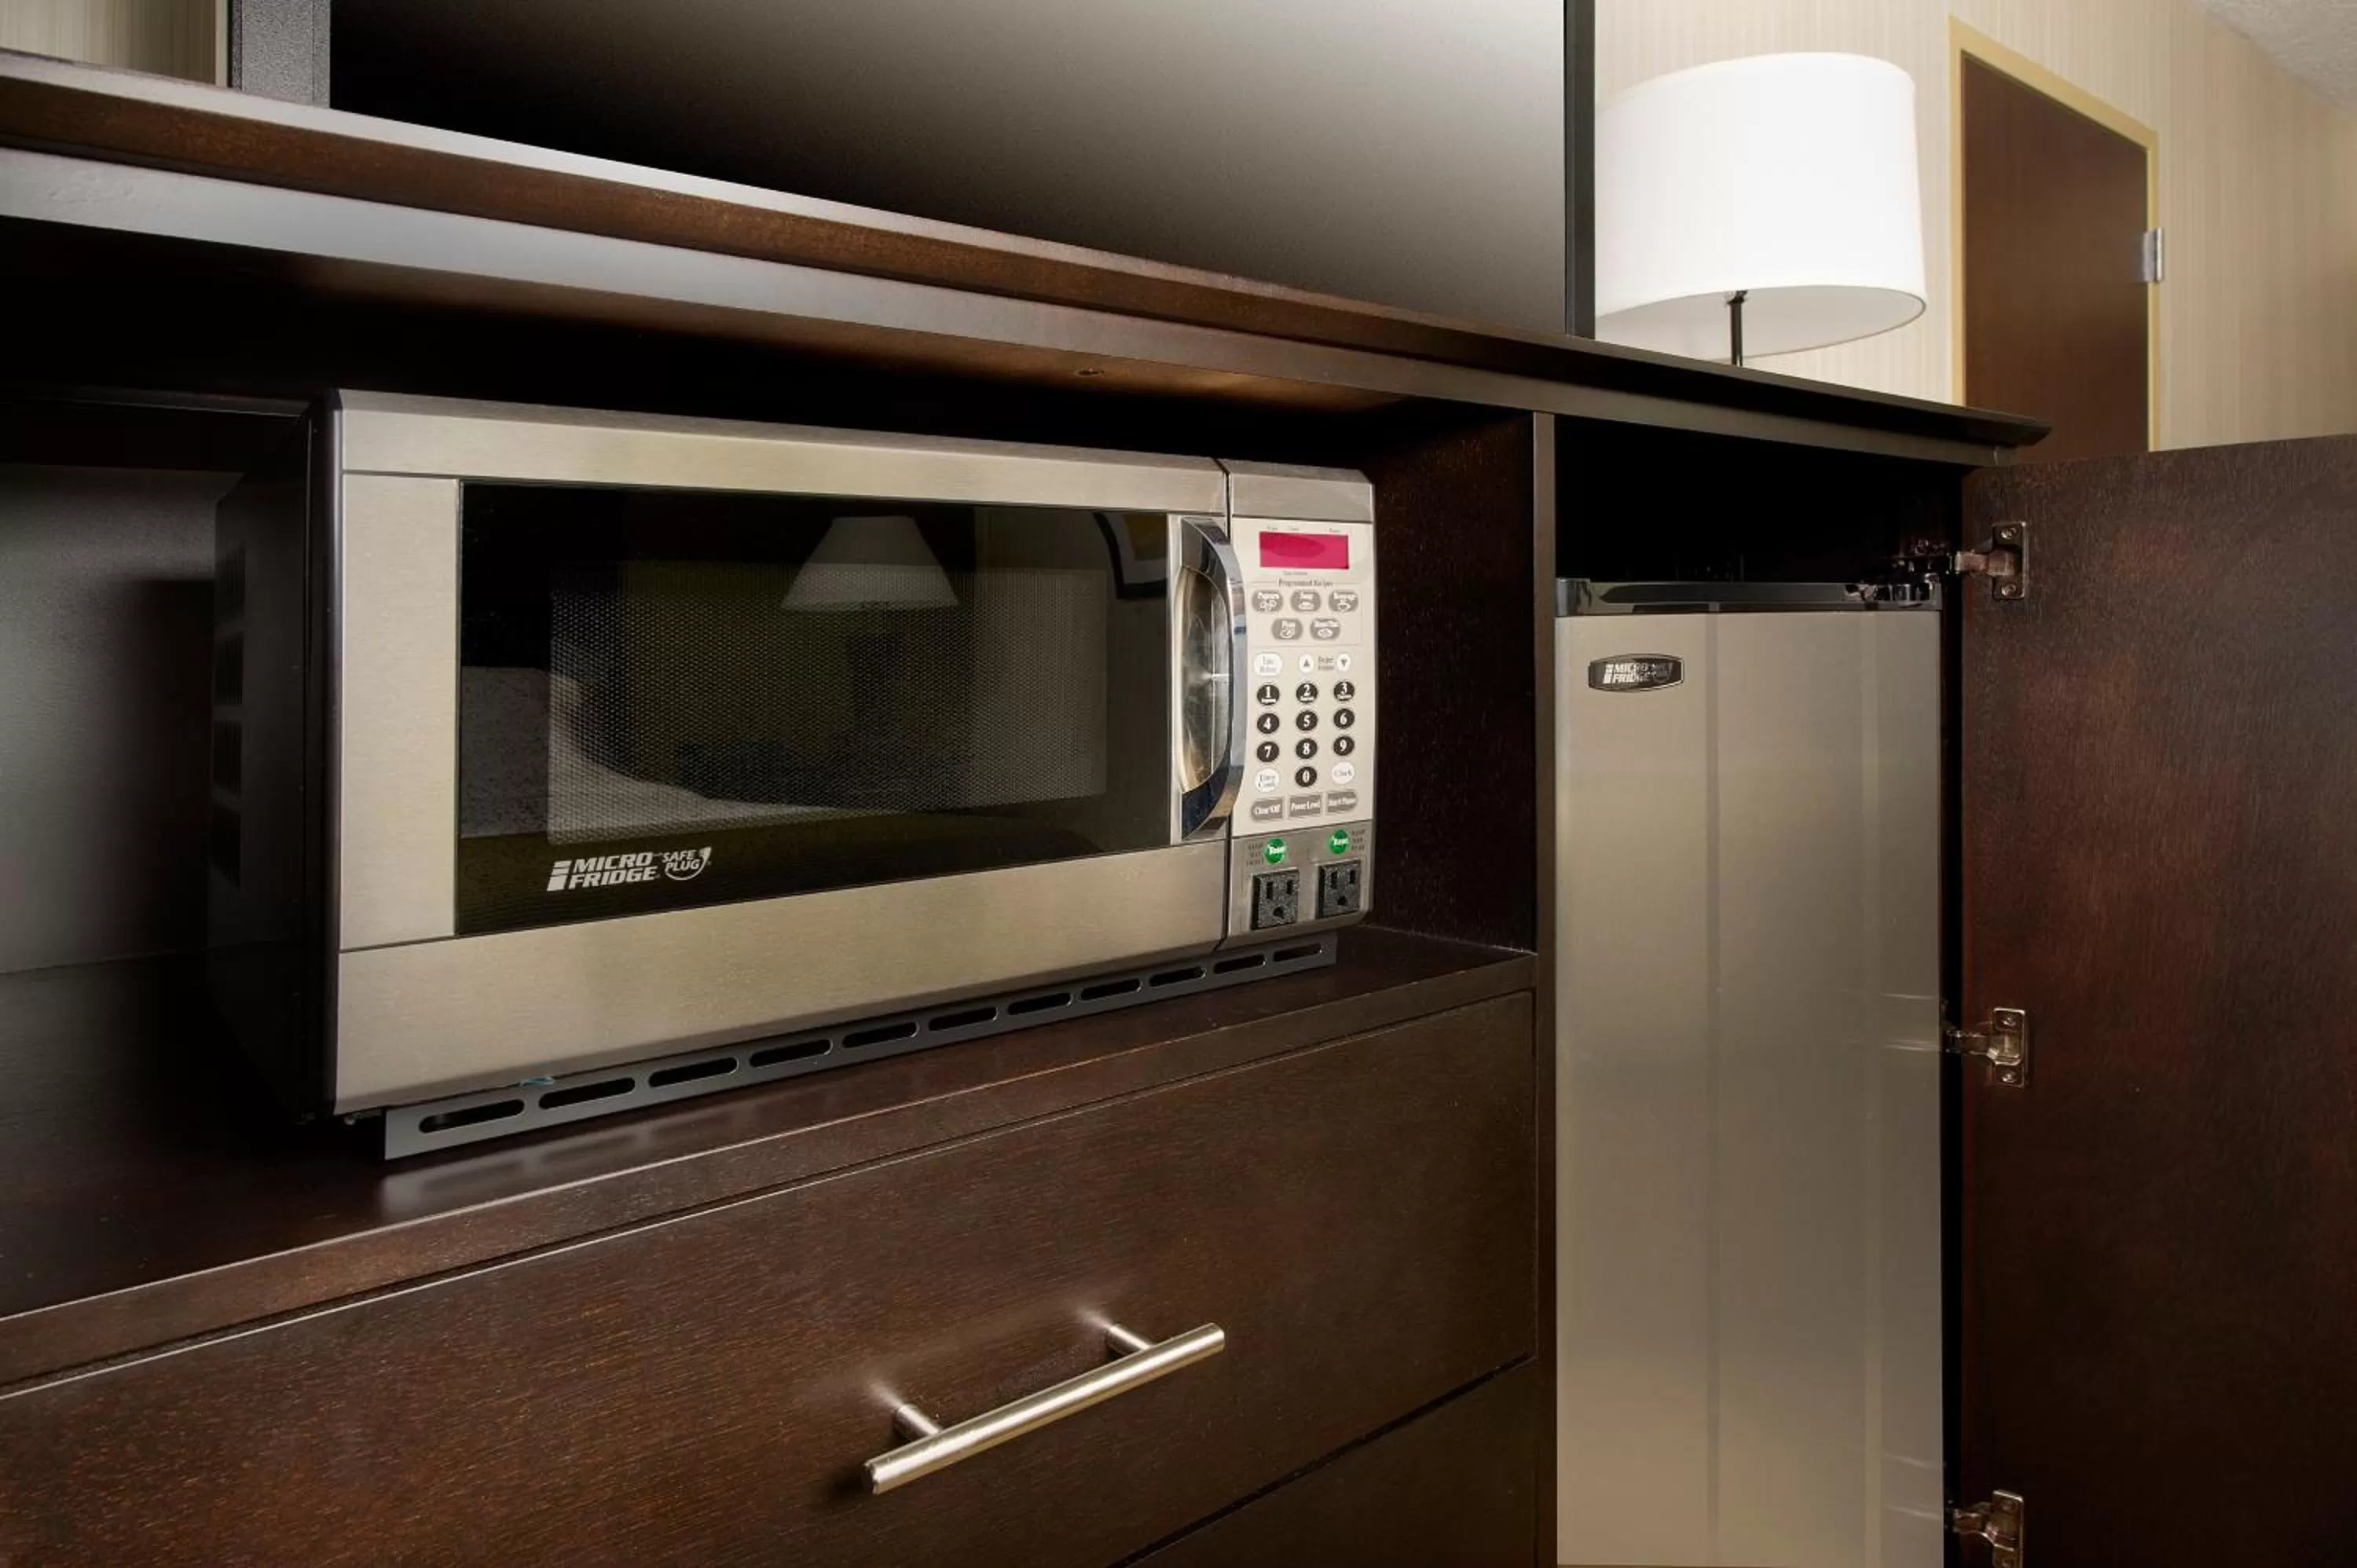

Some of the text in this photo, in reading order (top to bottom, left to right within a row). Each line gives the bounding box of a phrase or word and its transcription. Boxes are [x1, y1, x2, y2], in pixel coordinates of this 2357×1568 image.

[1303, 683, 1311, 696] 2
[1340, 682, 1348, 695] 3
[1263, 716, 1271, 730] 4
[1303, 714, 1311, 727] 5
[1339, 712, 1347, 725] 6
[1263, 745, 1272, 758] 7
[1302, 742, 1310, 755] 8
[1340, 738, 1347, 752] 9
[1302, 770, 1310, 783] 0
[662, 849, 697, 863] SAFE
[573, 852, 654, 874] MICRO
[665, 859, 701, 871] PLUG
[568, 866, 658, 890] FRIDGE
